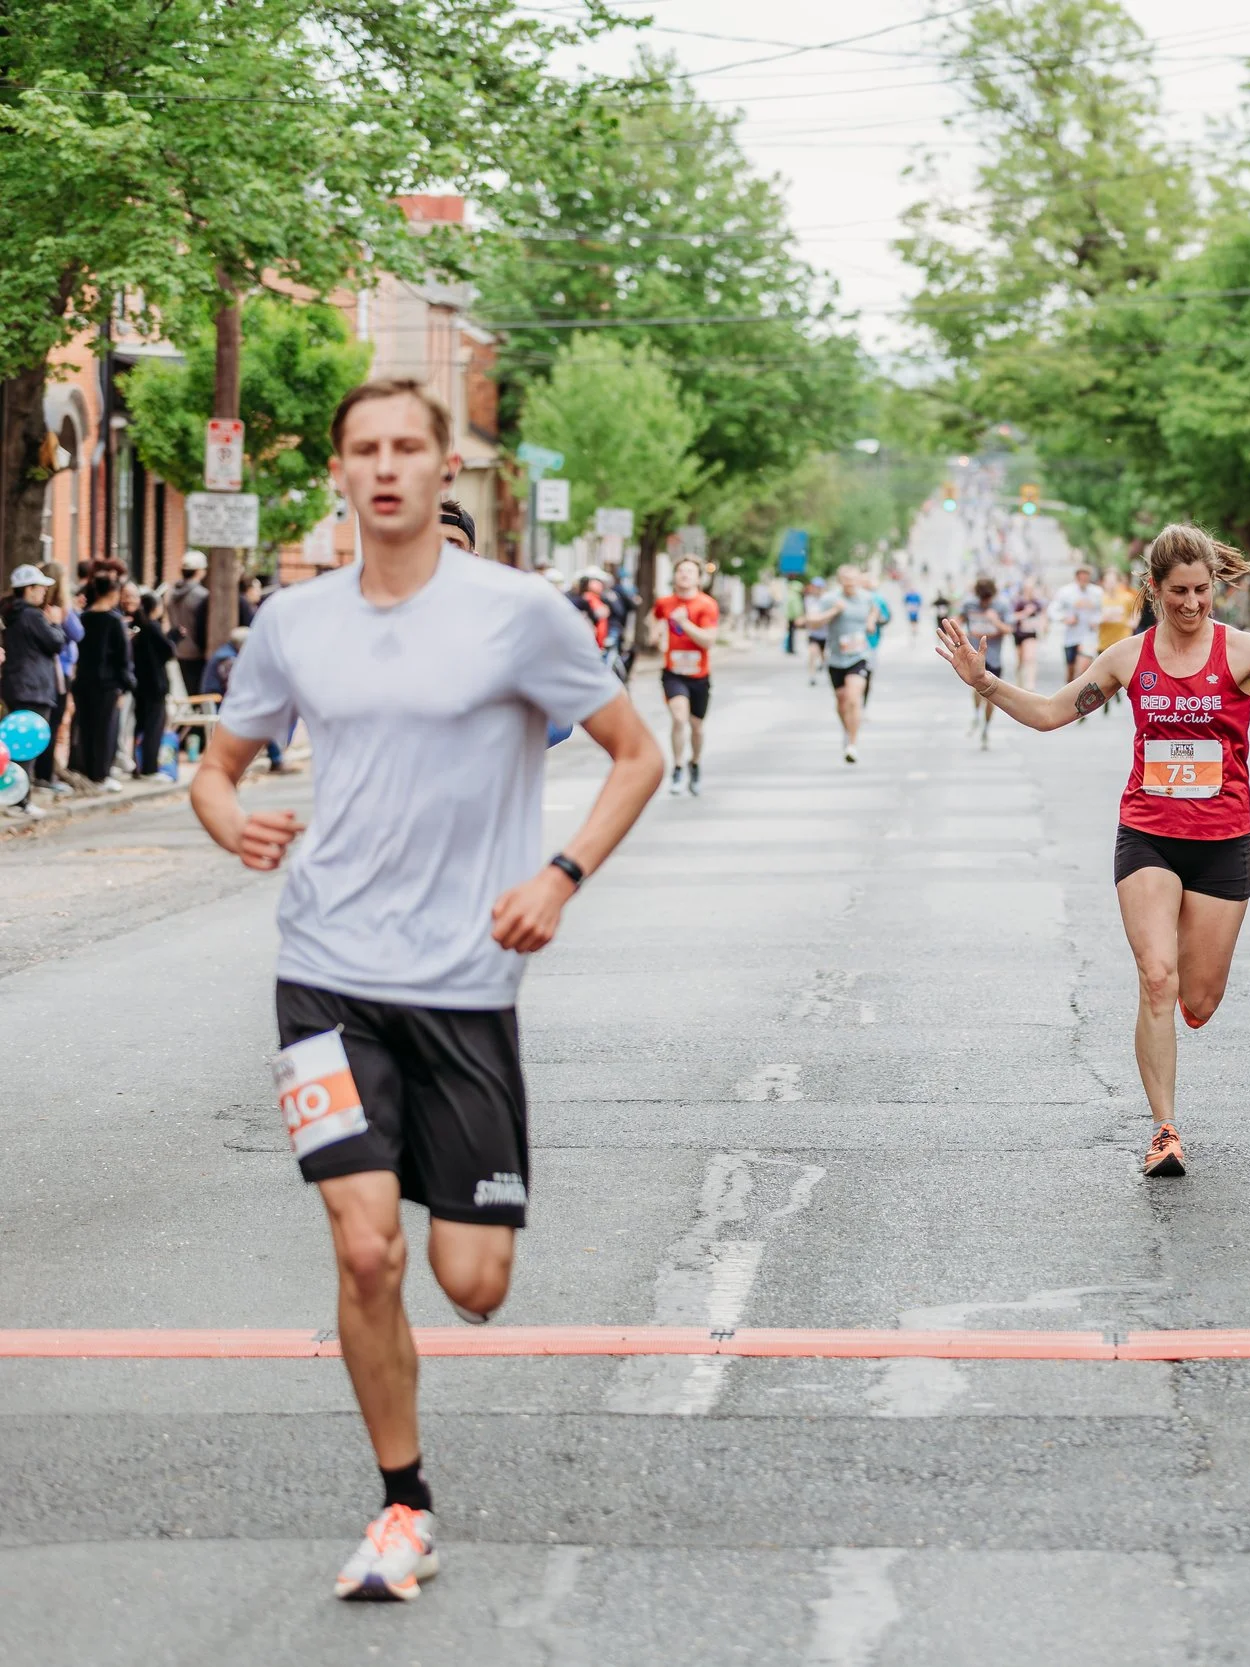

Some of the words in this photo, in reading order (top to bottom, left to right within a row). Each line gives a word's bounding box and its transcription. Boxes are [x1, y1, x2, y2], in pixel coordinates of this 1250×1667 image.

[1140, 695, 1171, 710] RED
[1175, 695, 1222, 711] ROSE
[1147, 712, 1183, 723] Track
[1183, 713, 1214, 723] Club
[1166, 764, 1197, 783] 75
